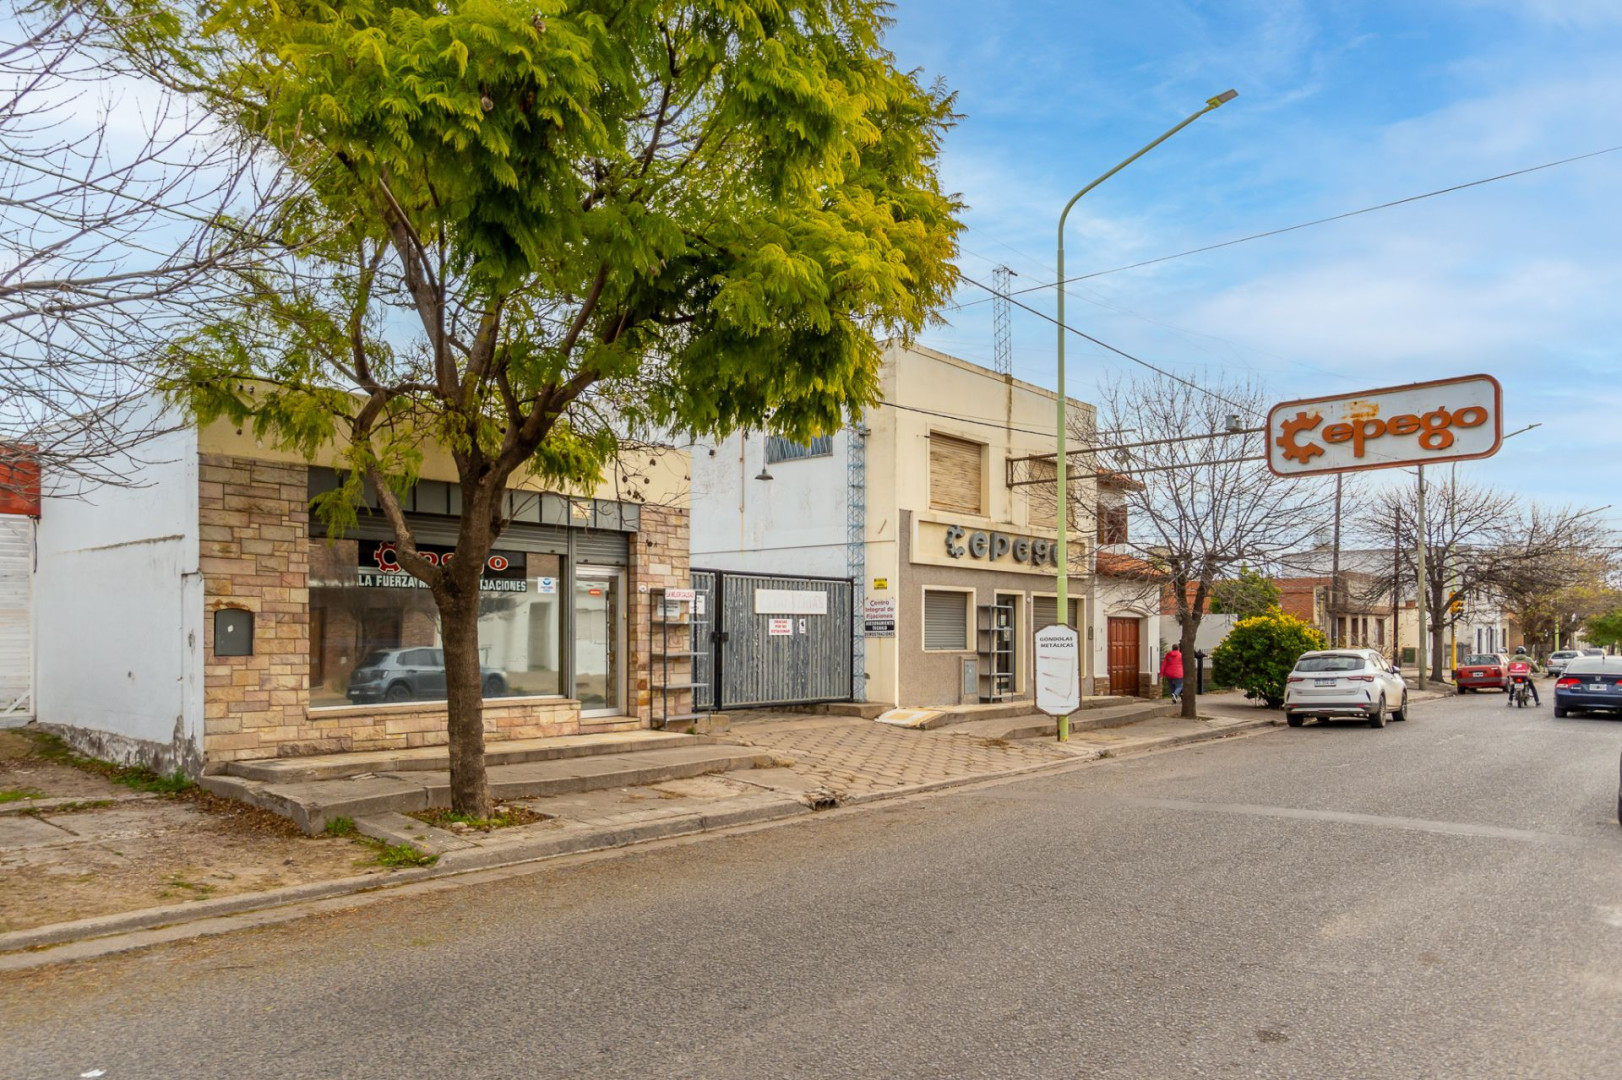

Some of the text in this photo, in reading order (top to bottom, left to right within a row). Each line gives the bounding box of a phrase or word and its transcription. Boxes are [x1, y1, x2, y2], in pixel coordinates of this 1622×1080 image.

[1276, 406, 1488, 464] Cepego
[358, 575, 373, 587] LA
[376, 576, 415, 588] FUERZA
[480, 579, 526, 592] IJACIONES
